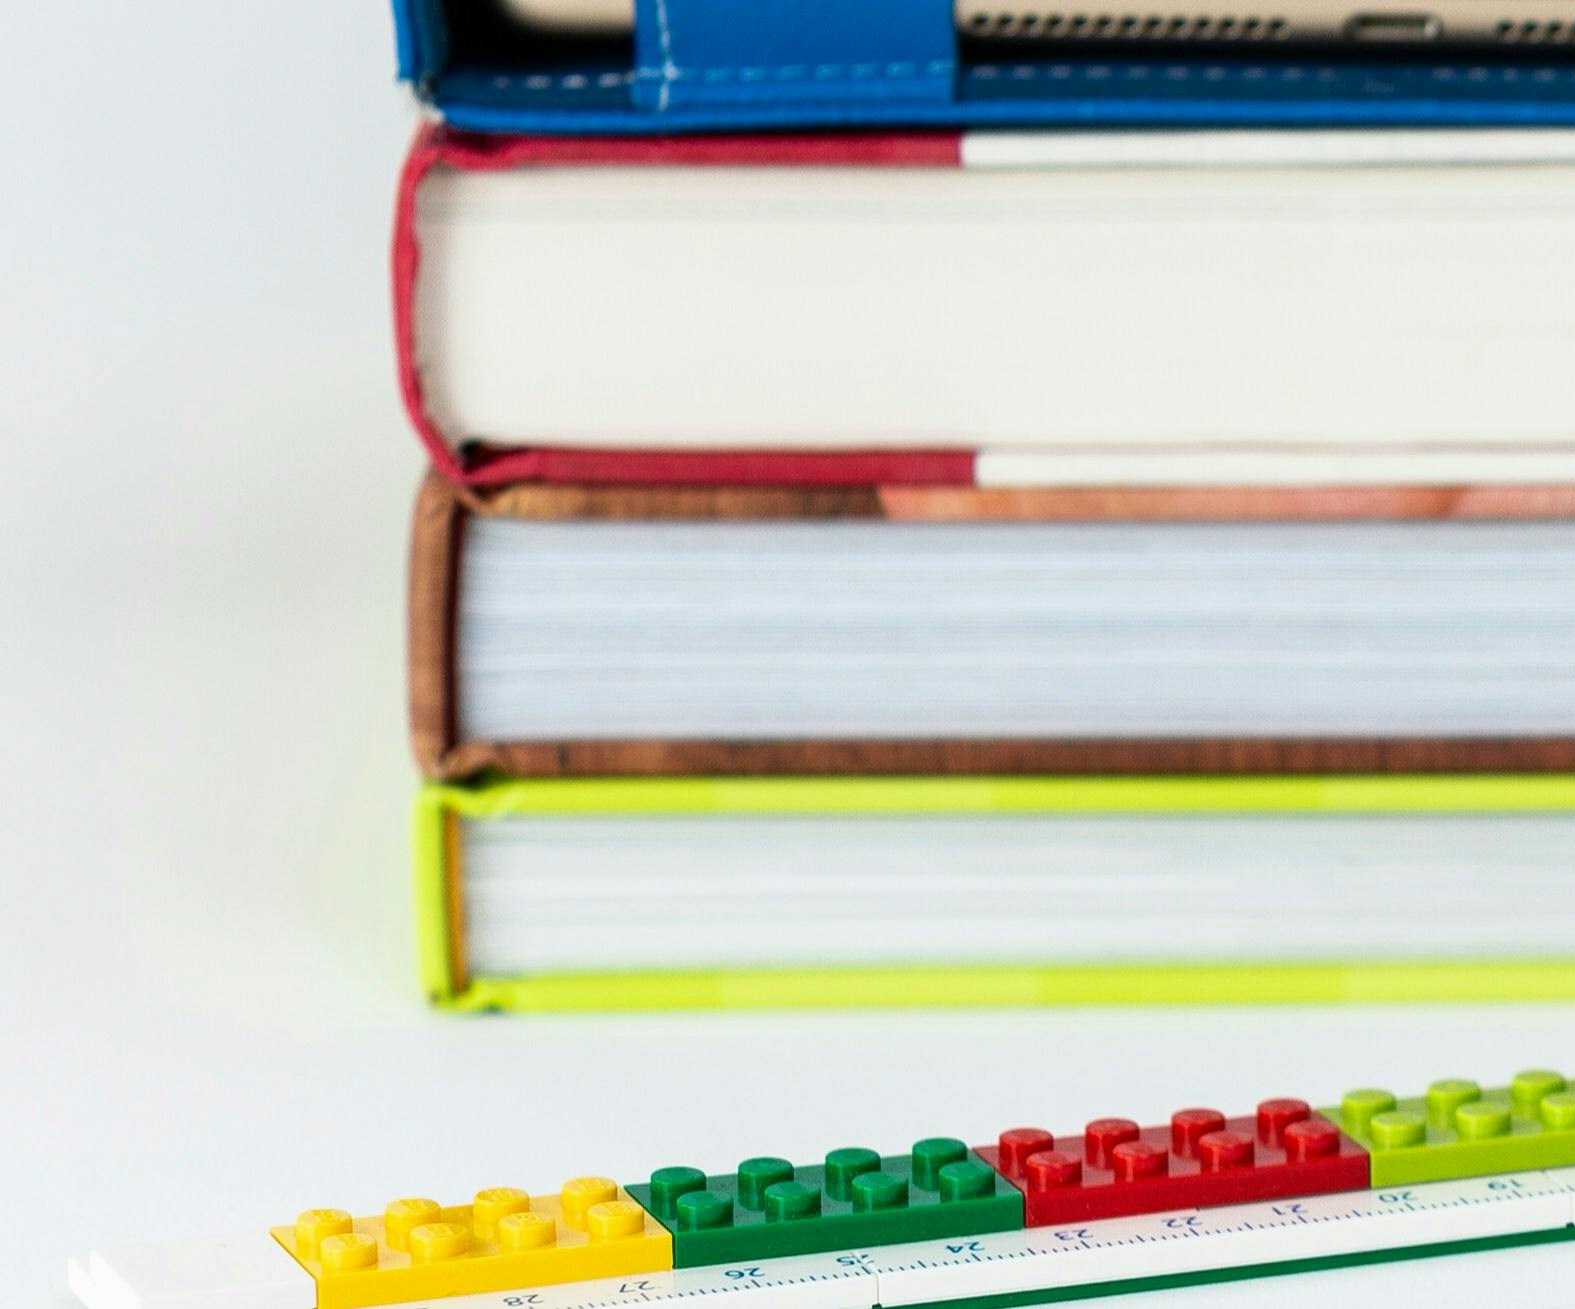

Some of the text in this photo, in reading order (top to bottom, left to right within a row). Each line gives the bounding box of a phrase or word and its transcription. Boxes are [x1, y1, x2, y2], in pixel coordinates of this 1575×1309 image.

[1487, 1179, 1523, 1190] 19
[1378, 1191, 1417, 1203] 20
[1271, 1203, 1308, 1216] 21
[1160, 1216, 1202, 1228] 22
[1054, 1228, 1094, 1241] 23
[945, 1241, 985, 1253] 24
[836, 1254, 874, 1266] 25
[724, 1267, 765, 1280] 26
[618, 1280, 656, 1294] 27
[503, 1294, 544, 1306] 28
